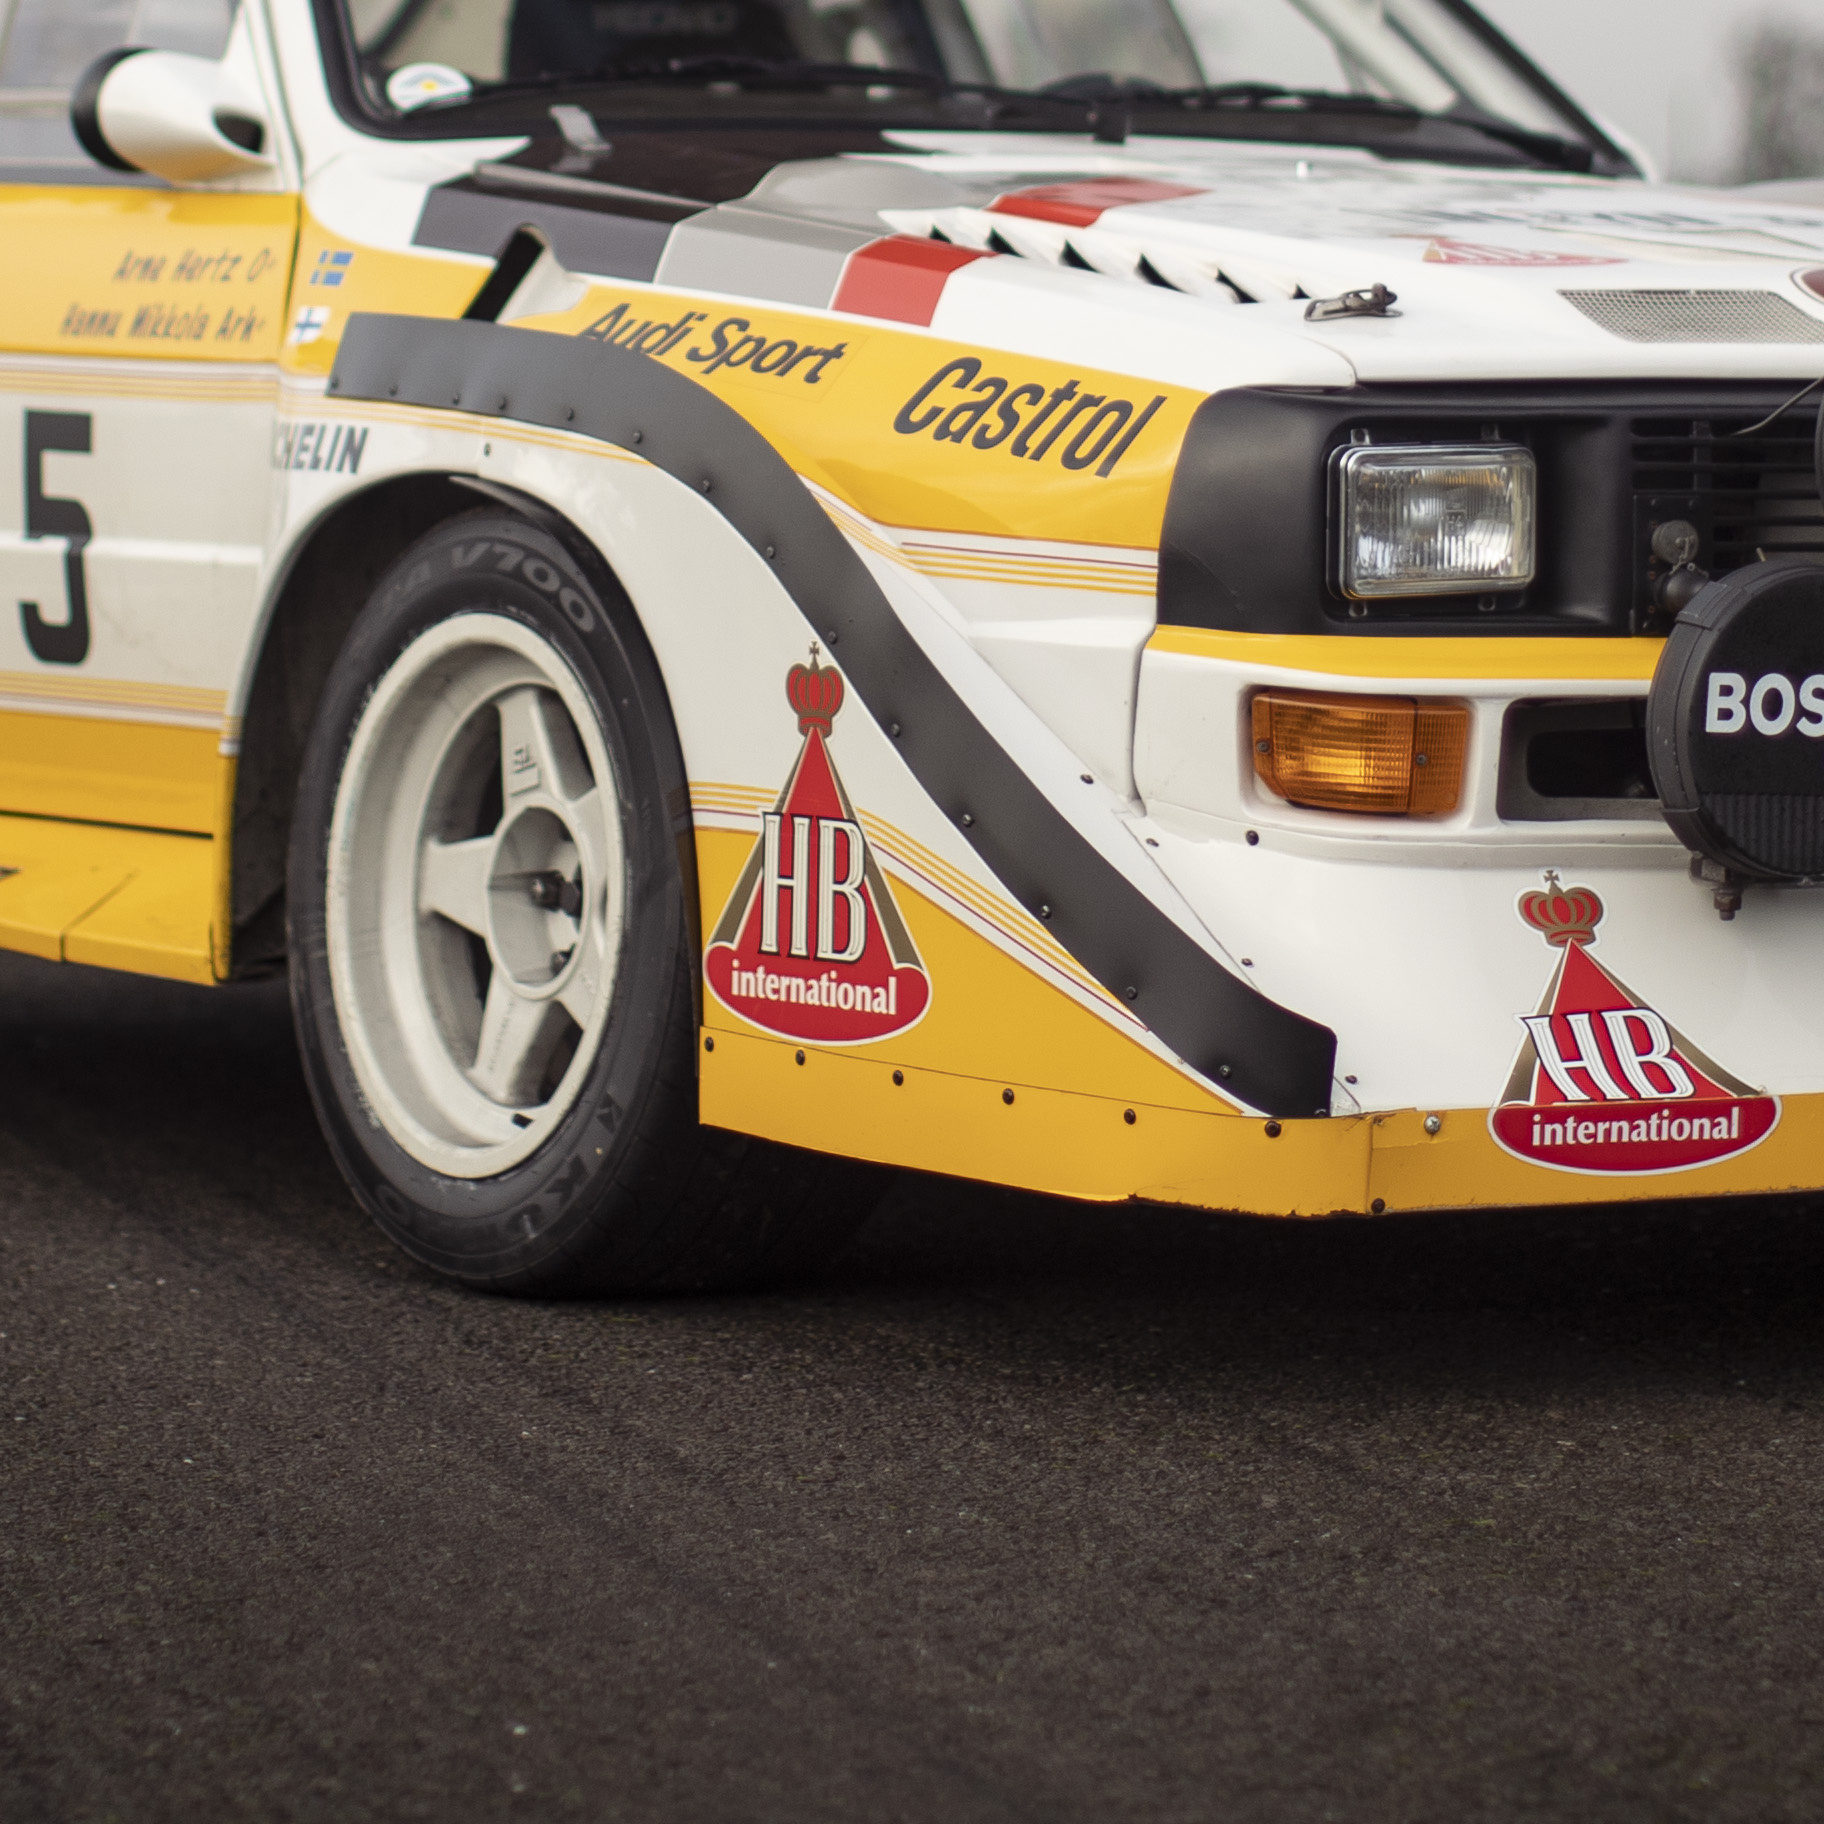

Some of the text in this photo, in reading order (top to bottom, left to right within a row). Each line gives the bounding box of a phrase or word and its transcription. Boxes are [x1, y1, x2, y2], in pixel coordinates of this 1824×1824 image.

[577, 307, 850, 385] Audi Sport
[894, 357, 1167, 479] Castrol
[19, 409, 93, 666] 5
[451, 540, 596, 633] V700
[757, 810, 868, 964] HB
[731, 959, 897, 1016] international
[1520, 1005, 1698, 1103] HB
[1531, 1106, 1742, 1147] international
